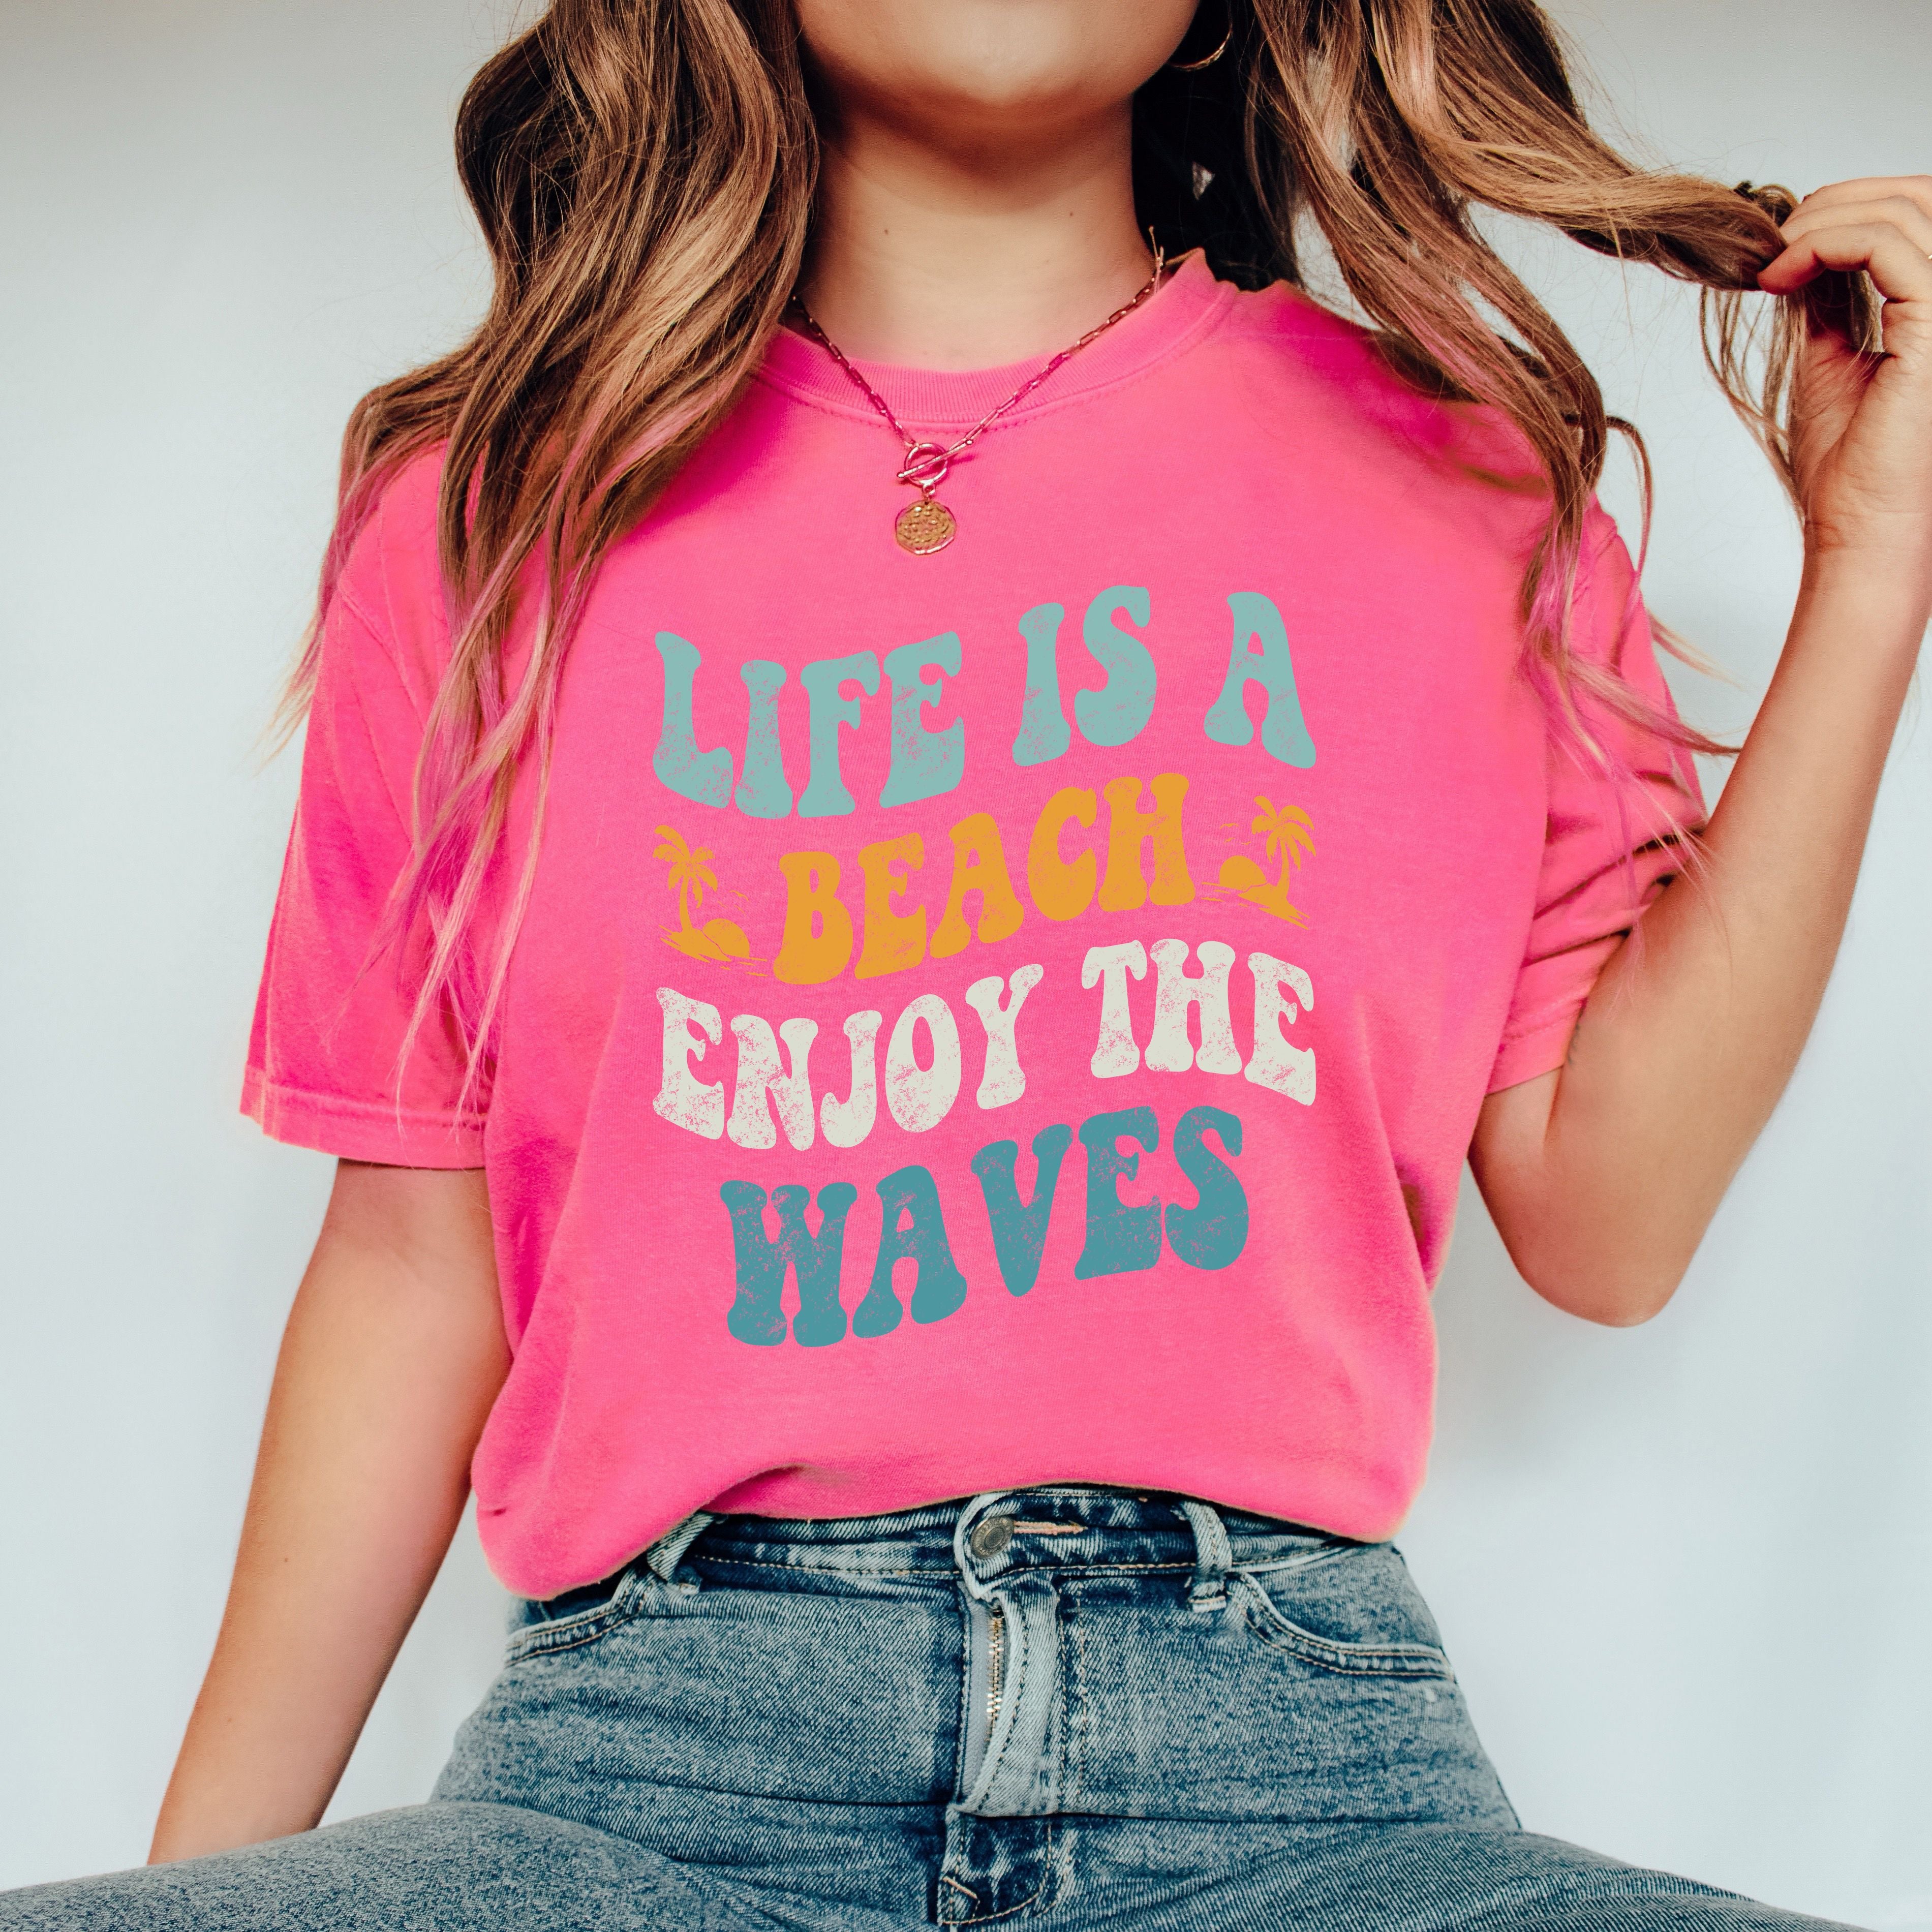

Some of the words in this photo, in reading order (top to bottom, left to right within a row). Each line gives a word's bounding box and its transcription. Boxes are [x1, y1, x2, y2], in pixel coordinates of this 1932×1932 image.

[652, 630, 965, 820] LIFE
[1012, 585, 1157, 767] IS
[1204, 591, 1316, 769] A
[773, 772, 1195, 985] BEACH
[652, 963, 1044, 1151] ENJOY
[1082, 938, 1316, 1107] THE
[720, 1106, 1249, 1347] WAVES
